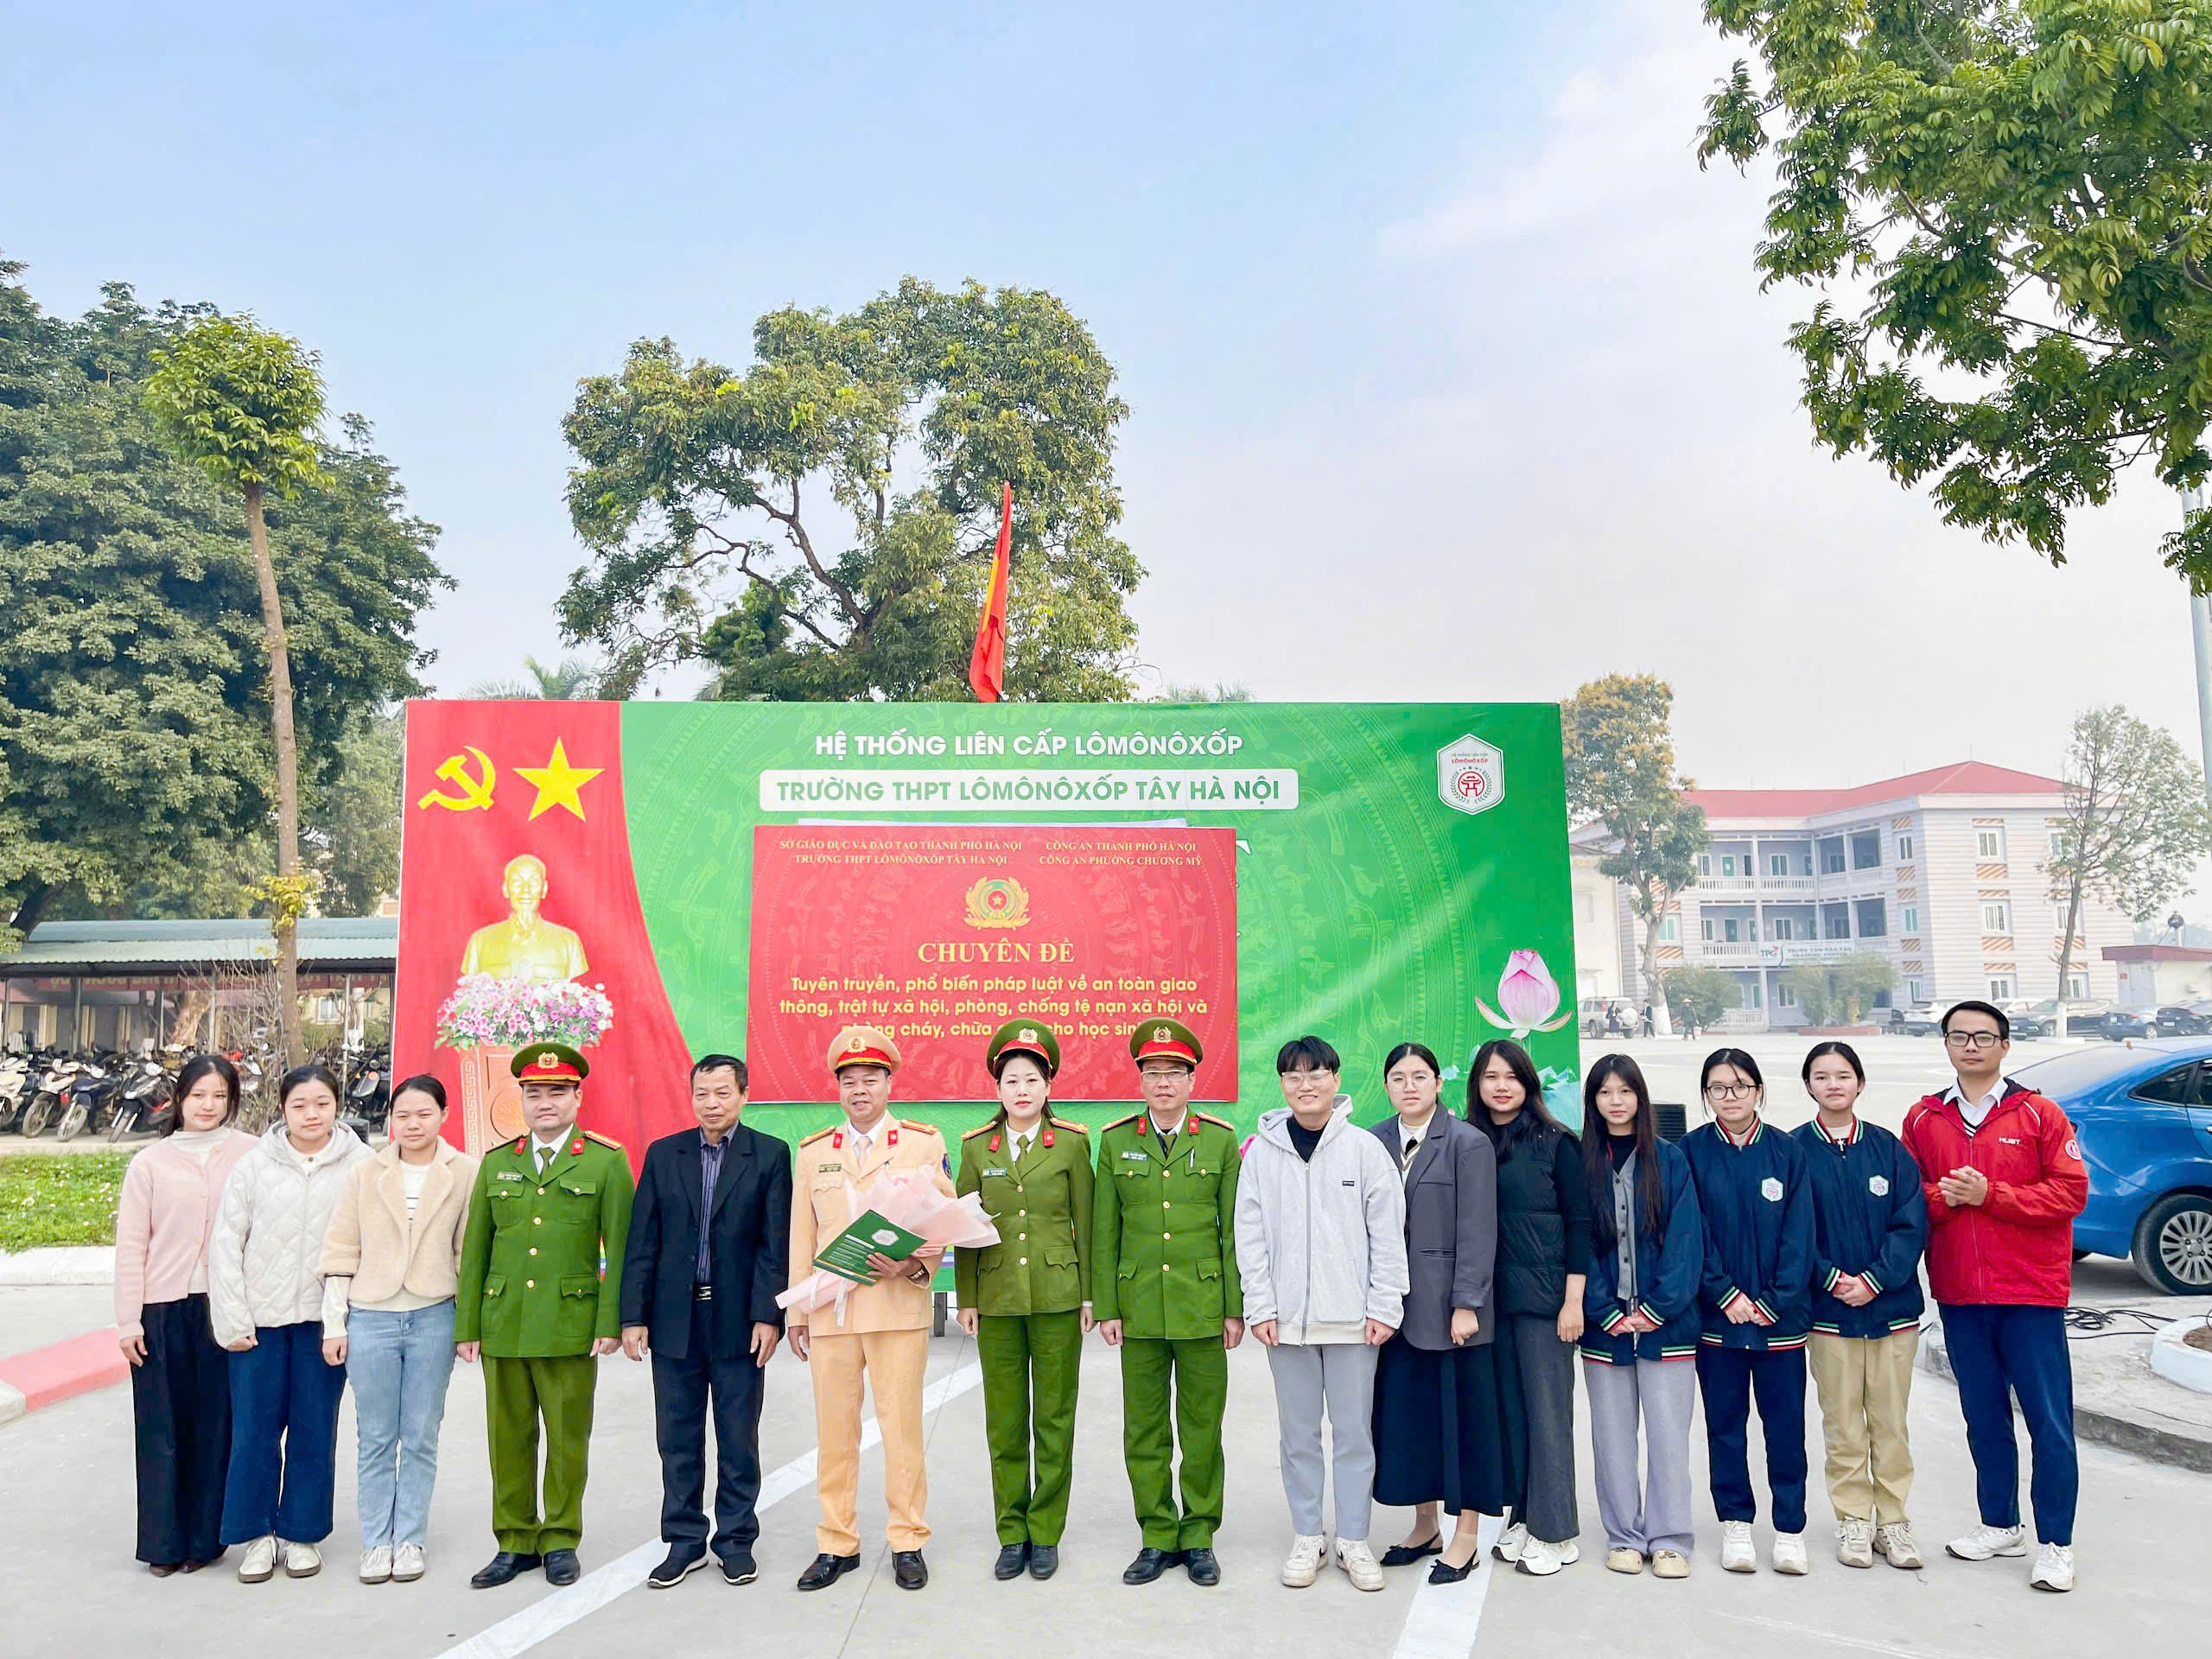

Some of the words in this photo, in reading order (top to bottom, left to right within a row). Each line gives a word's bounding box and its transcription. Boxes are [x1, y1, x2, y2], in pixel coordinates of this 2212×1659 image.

[816, 730, 847, 760] HỆ
[854, 728, 946, 755] THỐNG
[955, 730, 1004, 755] LIÊN
[1013, 728, 1067, 755] CẤP
[1075, 728, 1243, 755] LÔMÔNÔXỐP
[777, 776, 884, 801] TRƯỜNG
[893, 781, 951, 800] THPT
[960, 773, 1128, 801] LÔMÔNÔXỐP
[1135, 776, 1181, 800] TÂY
[1190, 775, 1225, 799] HÀ
[1234, 775, 1279, 804] NỘI
[797, 838, 824, 849] GIÁO
[827, 840, 850, 851] DỤC
[852, 838, 867, 849] VÀ
[894, 841, 918, 851] TẠO
[919, 839, 957, 849] THÀNH
[985, 839, 1001, 850] HÀ
[1002, 840, 1022, 852] NỘI
[1046, 840, 1077, 851] CÔNG
[1078, 842, 1093, 851] AN
[1096, 840, 1132, 851] THÀNH
[1160, 840, 1174, 851] HÀ
[1177, 841, 1196, 854] NỘI
[795, 854, 841, 864] TRƯỜNG
[843, 855, 871, 864] THPT
[946, 853, 967, 864] TÂY
[988, 855, 1007, 867] NỘI
[1039, 854, 1070, 865] CÔNG
[1072, 856, 1087, 865] AN
[1090, 855, 1135, 866] PHƯỜNG
[1136, 855, 1183, 866] CHƯƠNG
[1185, 853, 1203, 866] MỸ
[918, 937, 1032, 963] CHUYÊN
[1039, 937, 1075, 963] ĐỀ
[791, 976, 838, 994] Tuyên
[843, 973, 899, 994] truyền,
[906, 973, 938, 993] phổ
[943, 975, 978, 991] biến
[983, 976, 1027, 994] pháp
[1032, 976, 1063, 994] luật
[1068, 974, 1087, 991] về
[1092, 979, 1113, 991] an
[1118, 976, 1154, 991] toàn
[1160, 977, 1197, 995] giao
[779, 999, 833, 1017] thông,
[838, 999, 867, 1017] trật
[872, 999, 890, 1017] tự
[893, 999, 914, 1013] xã
[919, 999, 949, 1016] hội,
[955, 999, 1013, 1016] phòng,
[1018, 996, 1070, 1017] chống
[1075, 999, 1090, 1016] tệ
[1096, 1002, 1126, 1016] nạn
[1131, 999, 1152, 1013] xã
[1158, 999, 1182, 1016] hội
[1187, 999, 1208, 1013] và
[900, 1021, 944, 1038] cháy,
[950, 1020, 992, 1036] chữa
[1079, 1022, 1109, 1039] học
[1115, 1022, 1141, 1035] sin
[1999, 1136, 2021, 1145] HUST
